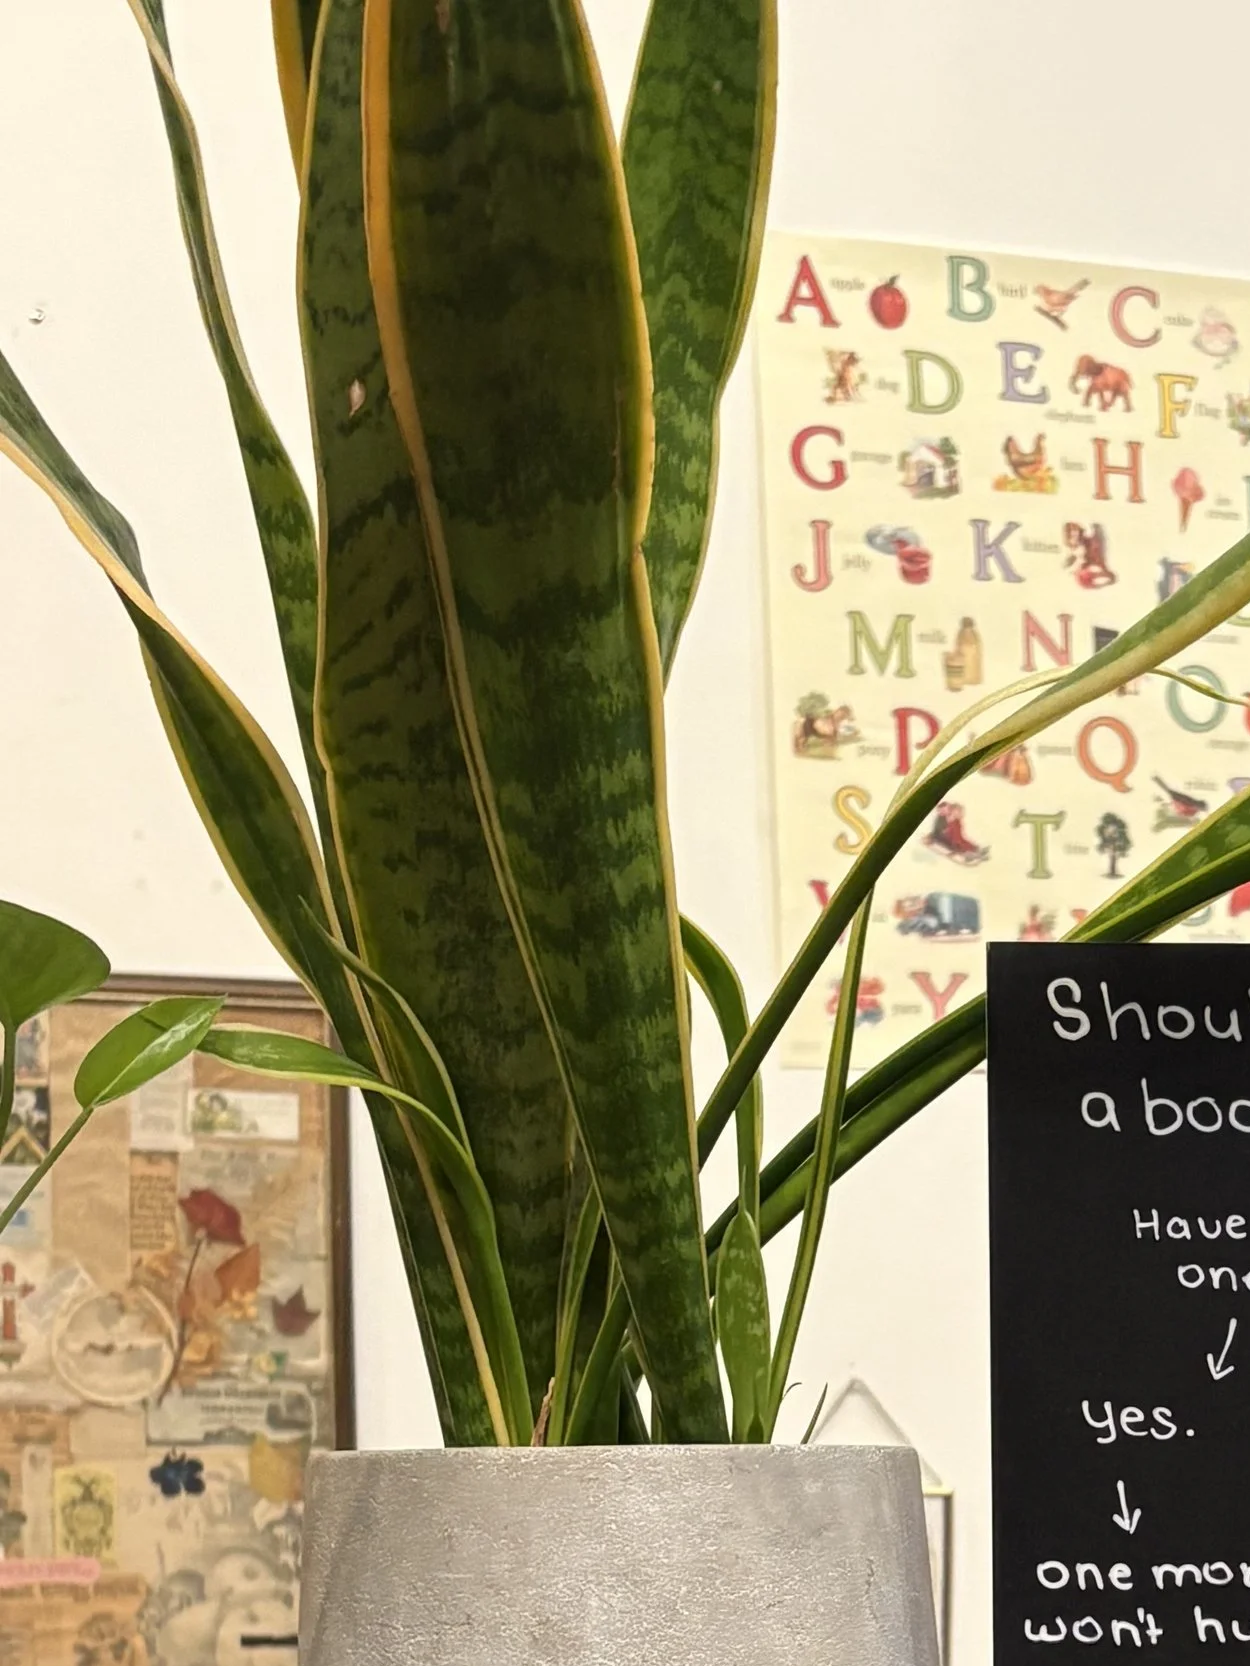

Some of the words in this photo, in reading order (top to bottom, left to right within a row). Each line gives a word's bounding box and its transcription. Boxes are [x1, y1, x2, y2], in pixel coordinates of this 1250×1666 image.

[776, 255, 842, 329] A
[945, 255, 996, 323] B
[1108, 285, 1162, 348] C
[902, 349, 963, 415] D
[996, 341, 1050, 404] E
[1153, 372, 1199, 439] F
[789, 425, 848, 491] G
[1091, 437, 1146, 503] H
[790, 519, 833, 592] J
[968, 518, 1026, 584] K
[846, 610, 917, 679] M
[1020, 609, 1075, 673] N
[1165, 665, 1230, 734] O
[892, 706, 943, 776] P
[1076, 715, 1140, 794] Q
[833, 784, 876, 855] S
[1012, 808, 1067, 880] T
[909, 970, 970, 1021] Y
[1081, 1092, 1121, 1132] a
[1133, 1208, 1248, 1240] Have
[1081, 1400, 1195, 1444] yes.
[1036, 1561, 1133, 1591] one
[1024, 1606, 1164, 1648] won't
